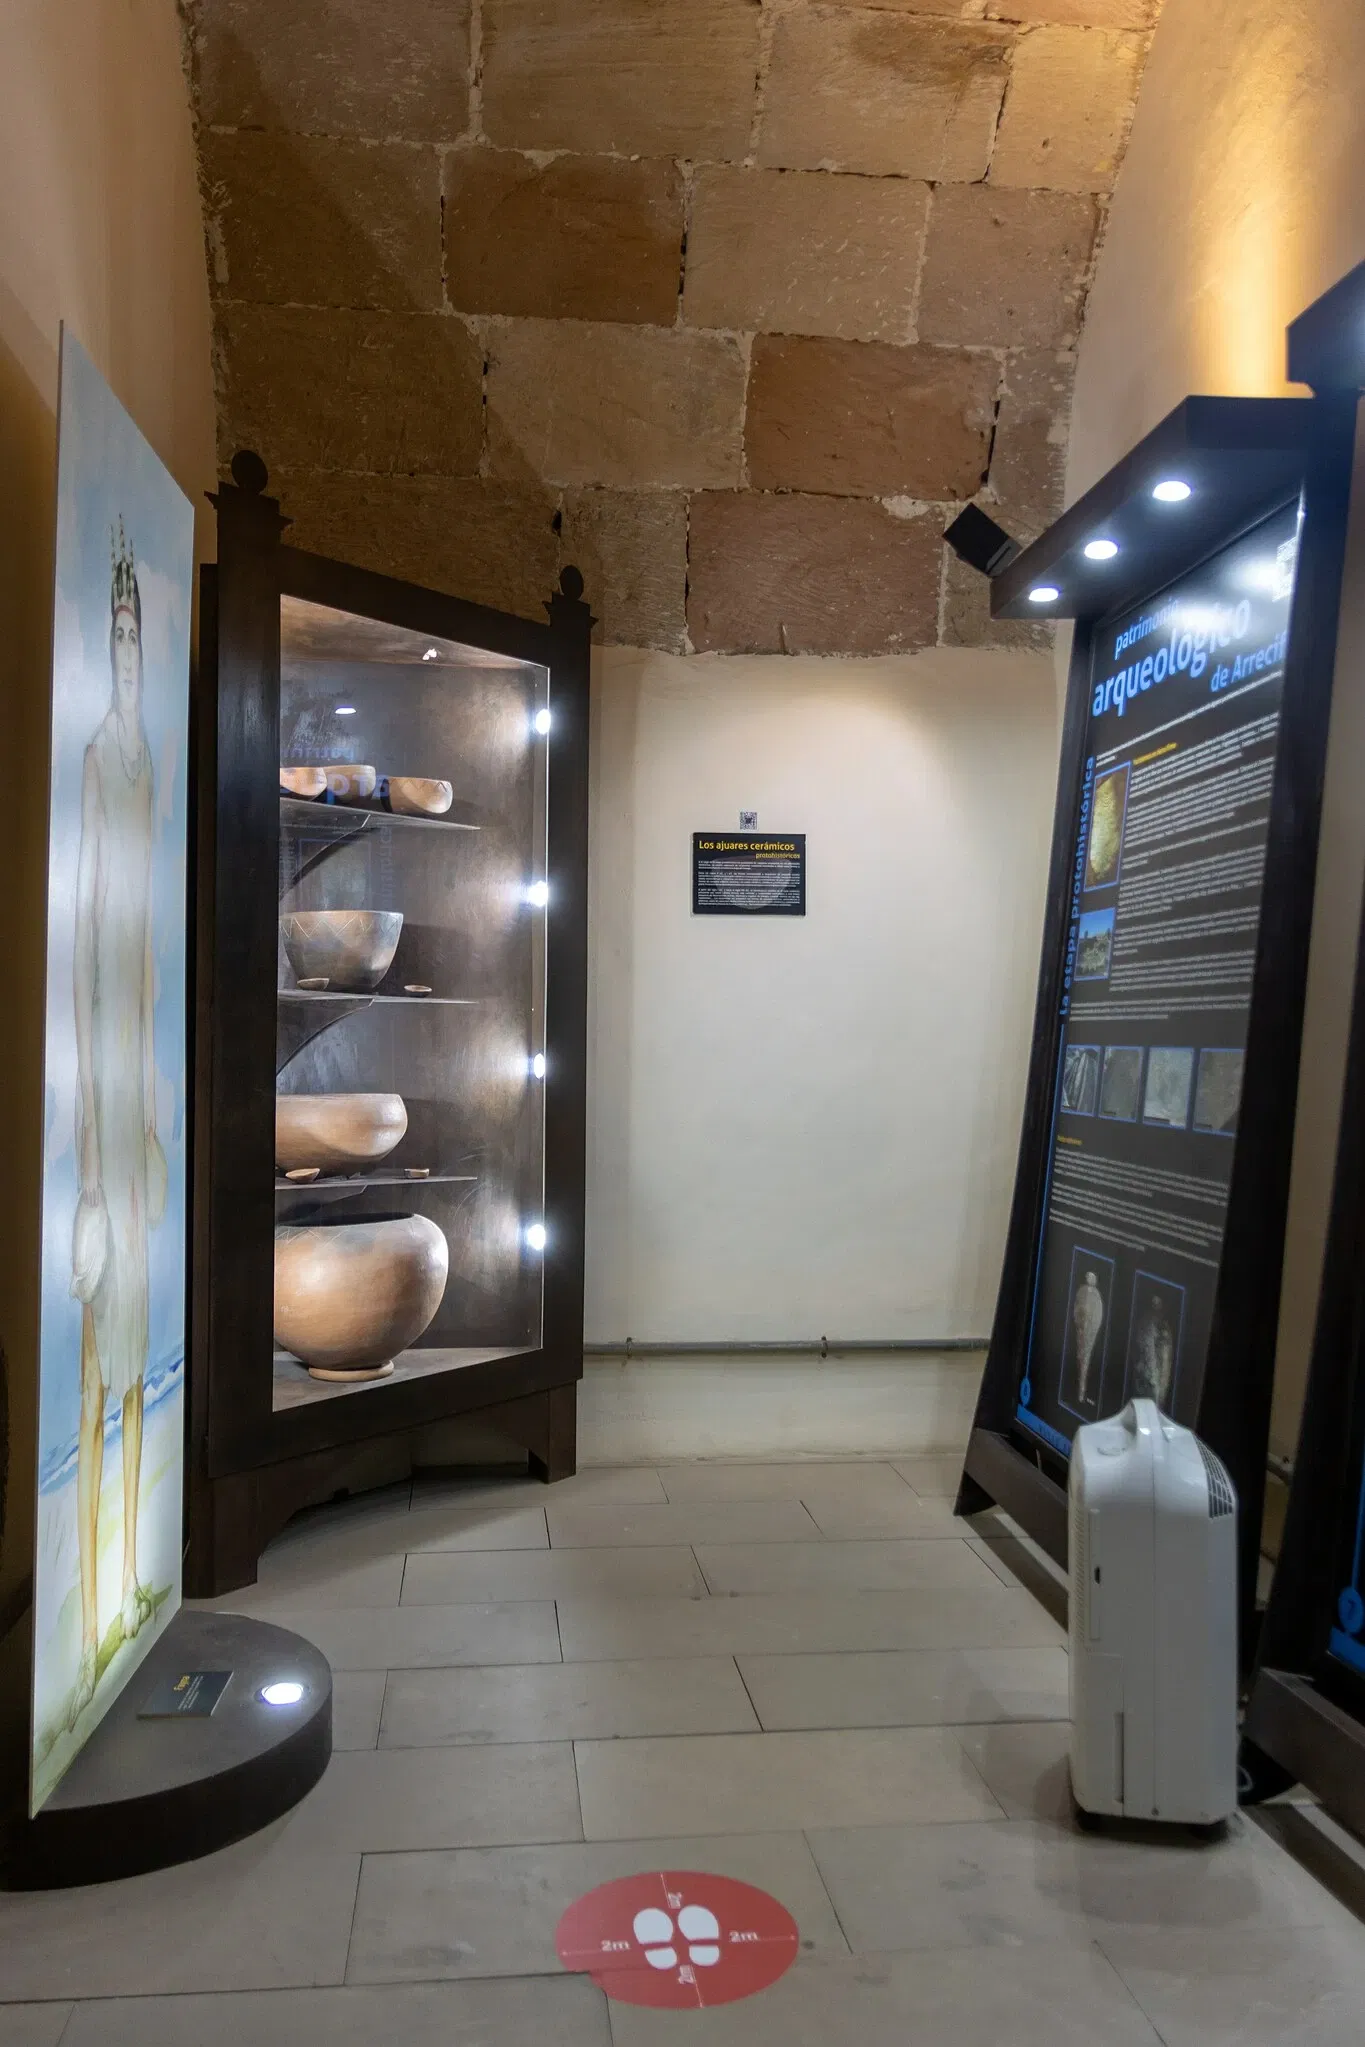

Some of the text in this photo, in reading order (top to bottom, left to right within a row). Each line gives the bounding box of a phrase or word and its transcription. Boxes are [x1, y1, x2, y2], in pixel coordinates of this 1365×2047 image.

[1210, 664, 1229, 692] de
[699, 840, 795, 851] Los ajuares cerámicos
[1064, 926, 1077, 989] etapa
[1071, 756, 1094, 919] protohistórica
[729, 1931, 759, 1943] 2m
[601, 1940, 631, 1952] 2m
